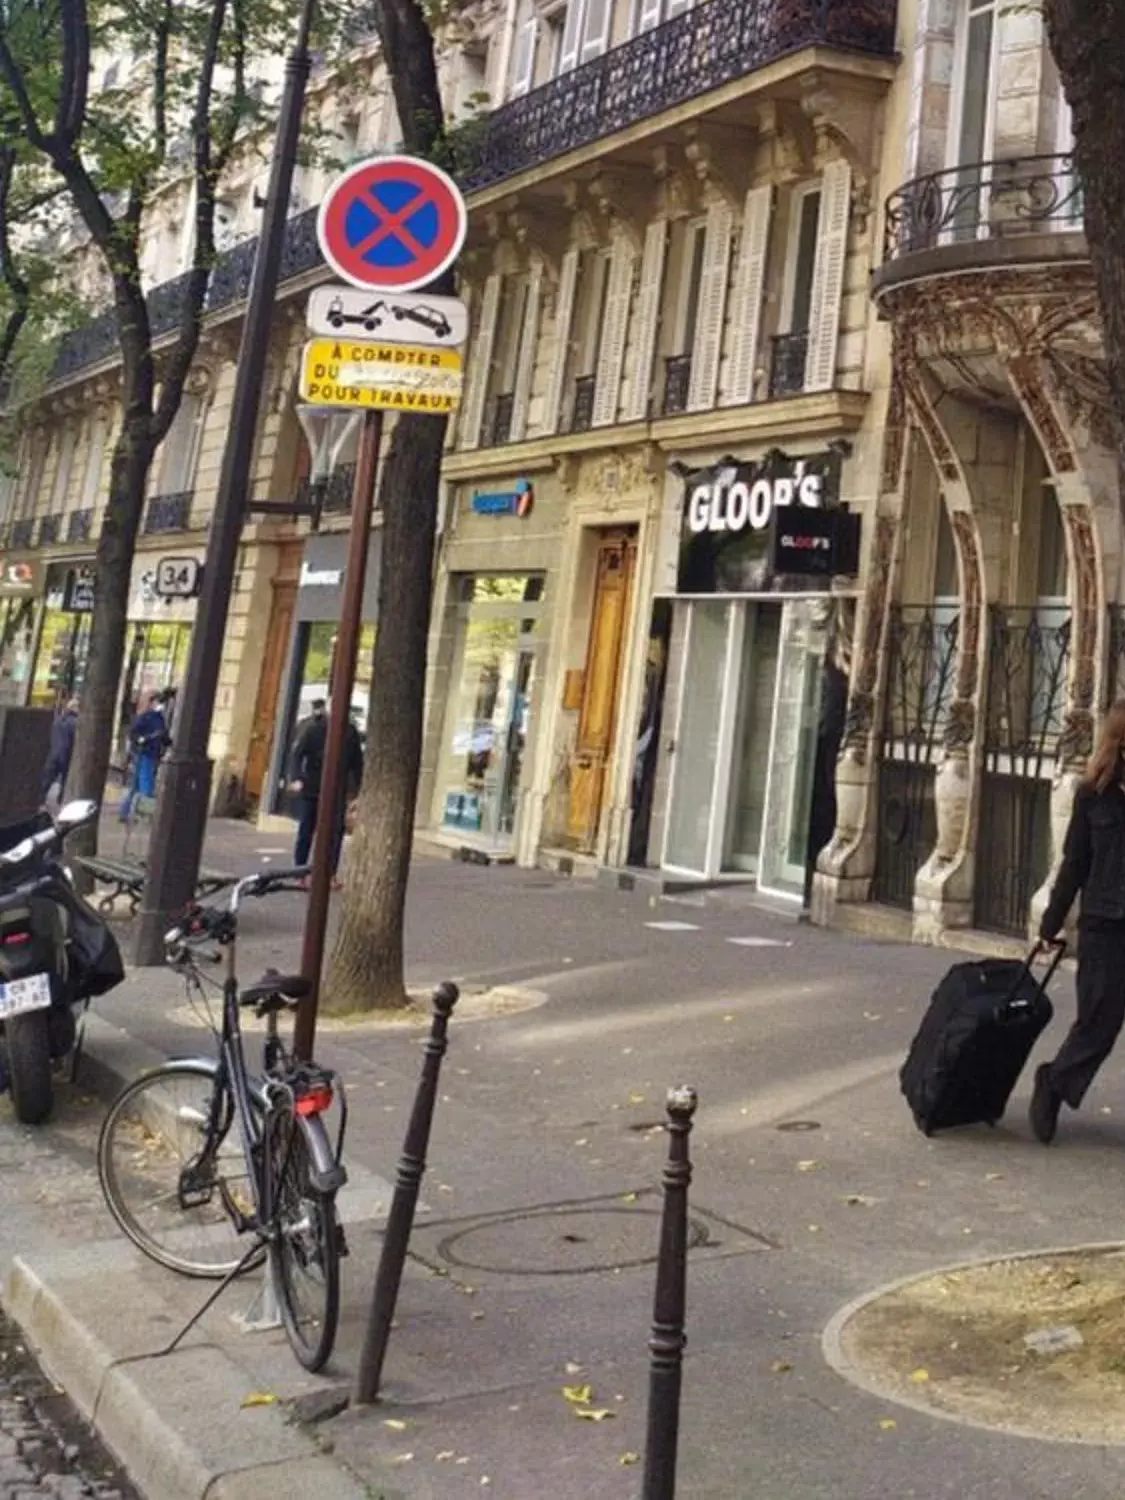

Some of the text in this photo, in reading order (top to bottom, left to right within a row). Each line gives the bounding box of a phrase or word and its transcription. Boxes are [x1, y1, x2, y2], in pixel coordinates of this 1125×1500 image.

[351, 347, 441, 367] COMPTER
[314, 364, 339, 379] DU
[309, 384, 453, 408] POUR TRAVAUX
[164, 566, 190, 587] 34
